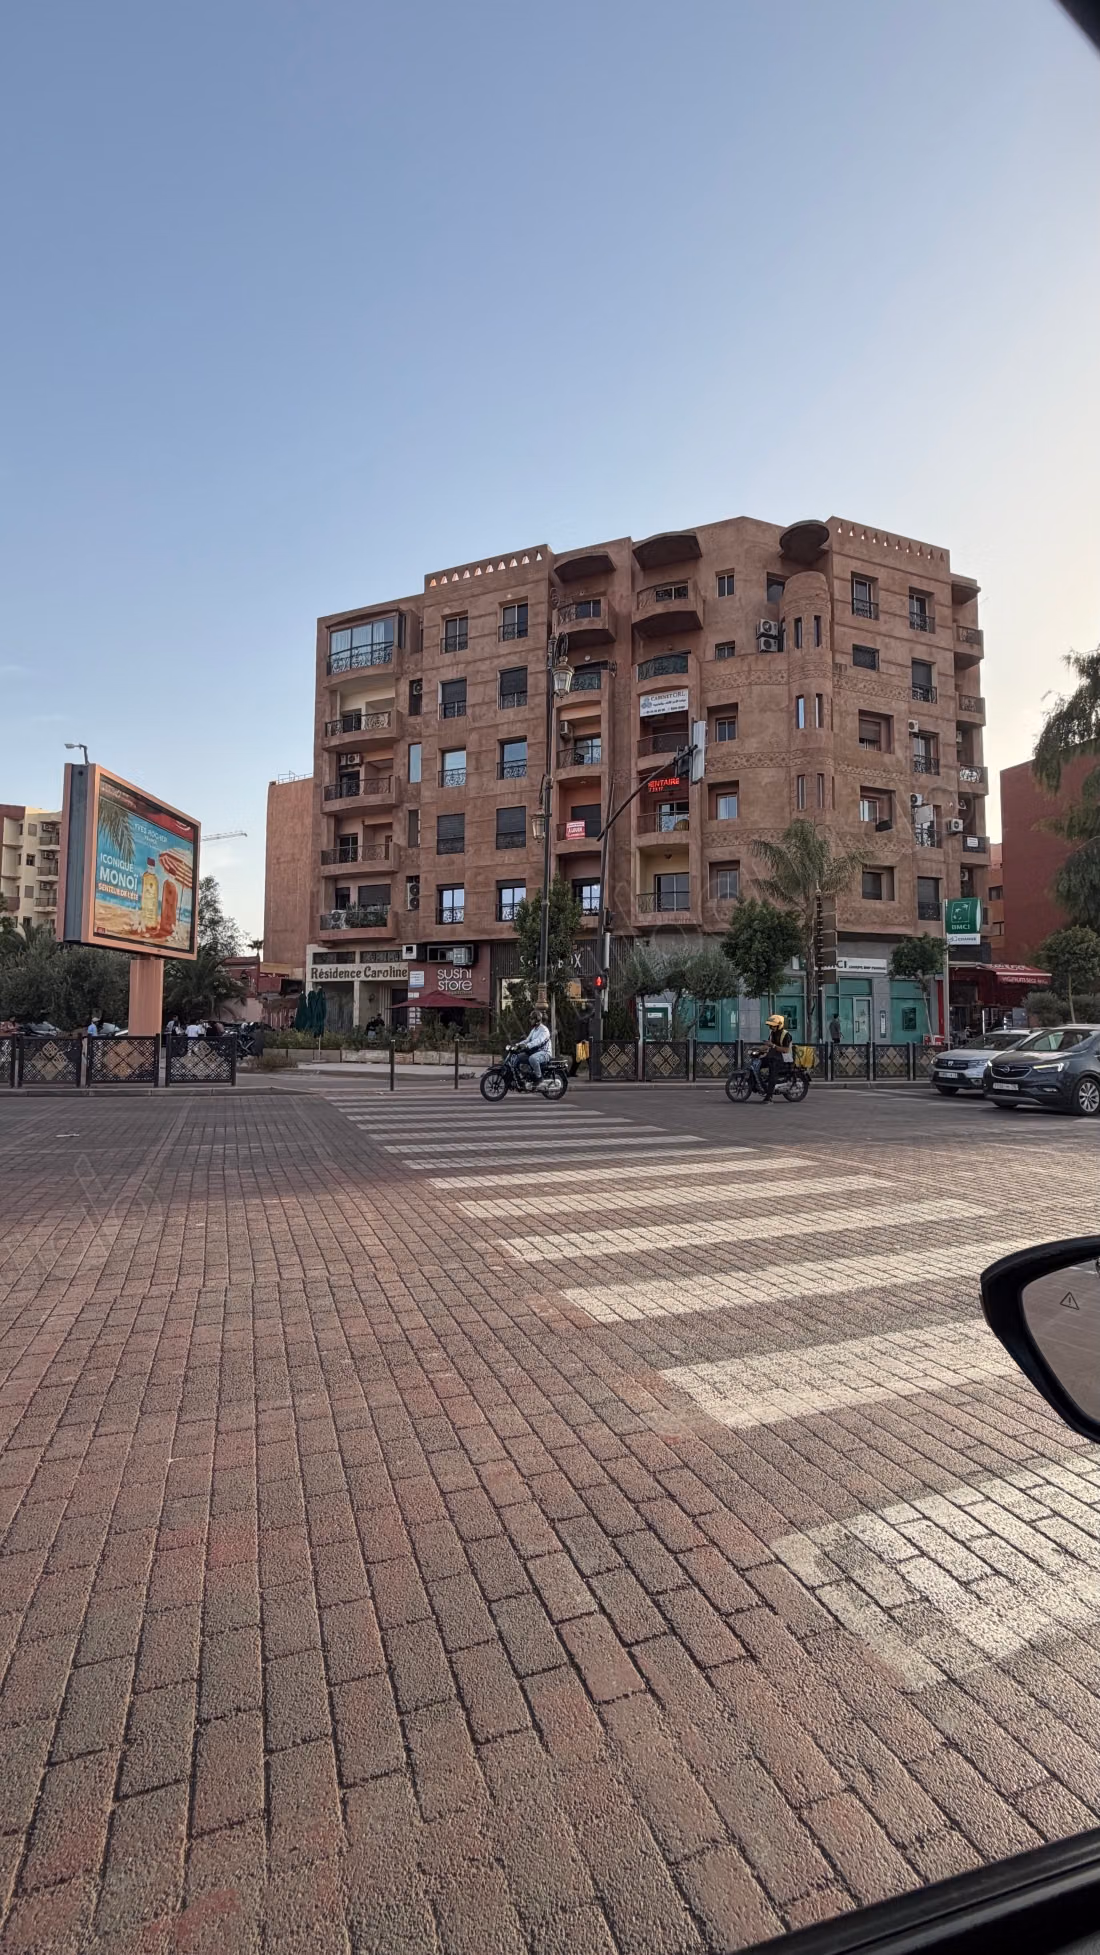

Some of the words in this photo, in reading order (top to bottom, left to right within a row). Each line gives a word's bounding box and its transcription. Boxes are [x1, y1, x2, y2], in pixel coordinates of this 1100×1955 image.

[100, 852, 134, 873] ICONIQUE
[99, 865, 139, 891] MONOÏ
[311, 966, 362, 980] Résidence
[363, 965, 408, 979] Caroline
[437, 967, 472, 980] sushi
[437, 979, 473, 991] store
